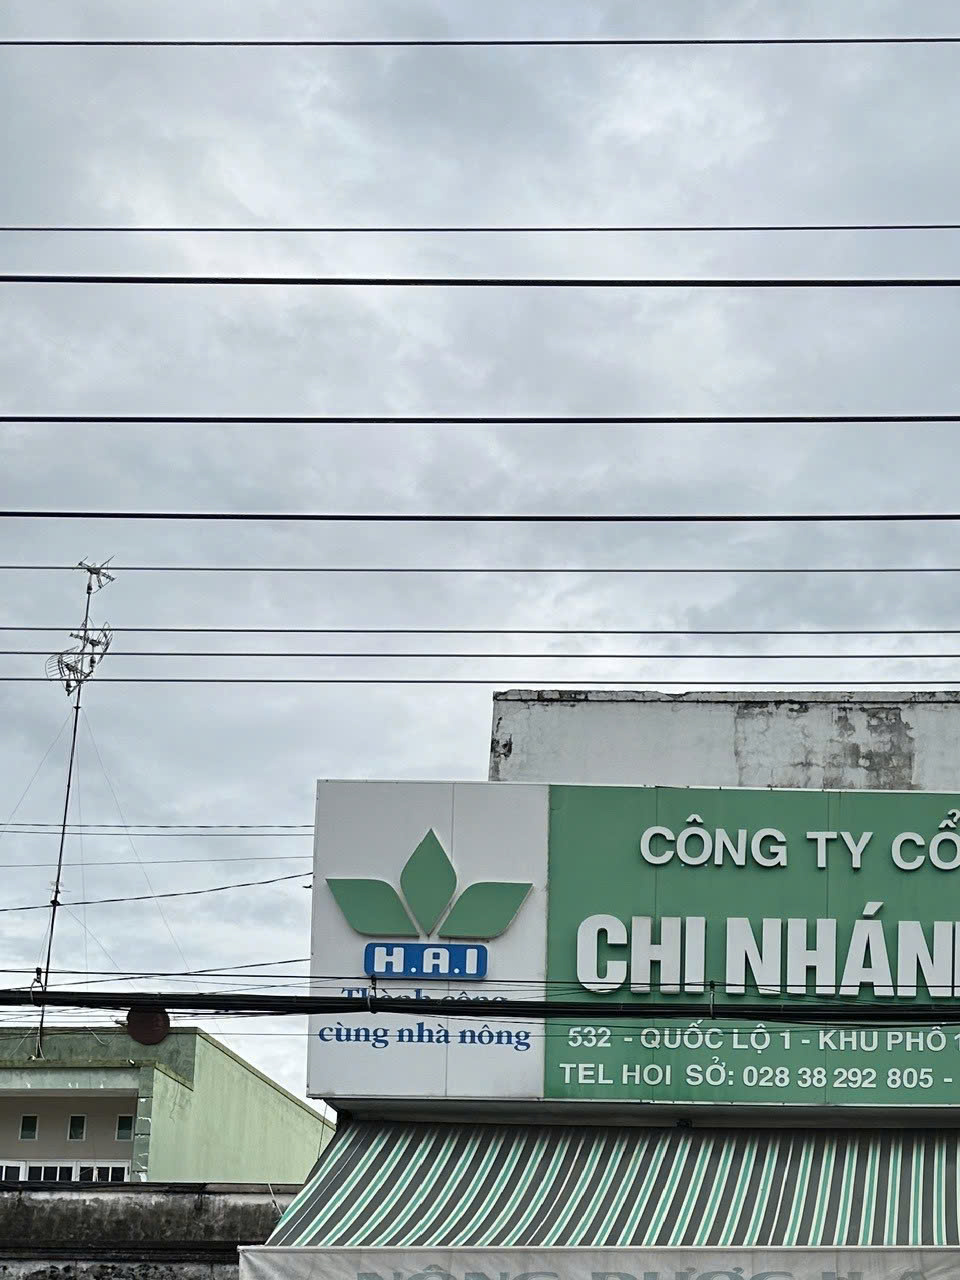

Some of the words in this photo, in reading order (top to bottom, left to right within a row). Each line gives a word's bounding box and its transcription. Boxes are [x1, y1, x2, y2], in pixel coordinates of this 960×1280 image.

[640, 814, 788, 867] CÔNG
[806, 831, 873, 870] TY
[373, 946, 478, 974] H.A.I
[576, 913, 706, 994] CHI
[318, 1022, 390, 1049] cùng
[396, 1022, 451, 1044] nhà
[458, 1024, 531, 1052] nông
[568, 1026, 611, 1048] 532
[640, 1020, 724, 1049] QUỐC
[732, 1024, 771, 1053] LỘ
[779, 1029, 791, 1050] 1
[818, 1030, 879, 1051] KHU
[559, 1063, 613, 1084] TEL
[622, 1064, 671, 1085] HOI
[686, 1056, 733, 1086] SỞ:
[743, 1066, 790, 1087] 028
[797, 1067, 827, 1088] 38
[833, 1068, 877, 1088] 292
[887, 1068, 934, 1088] 805
